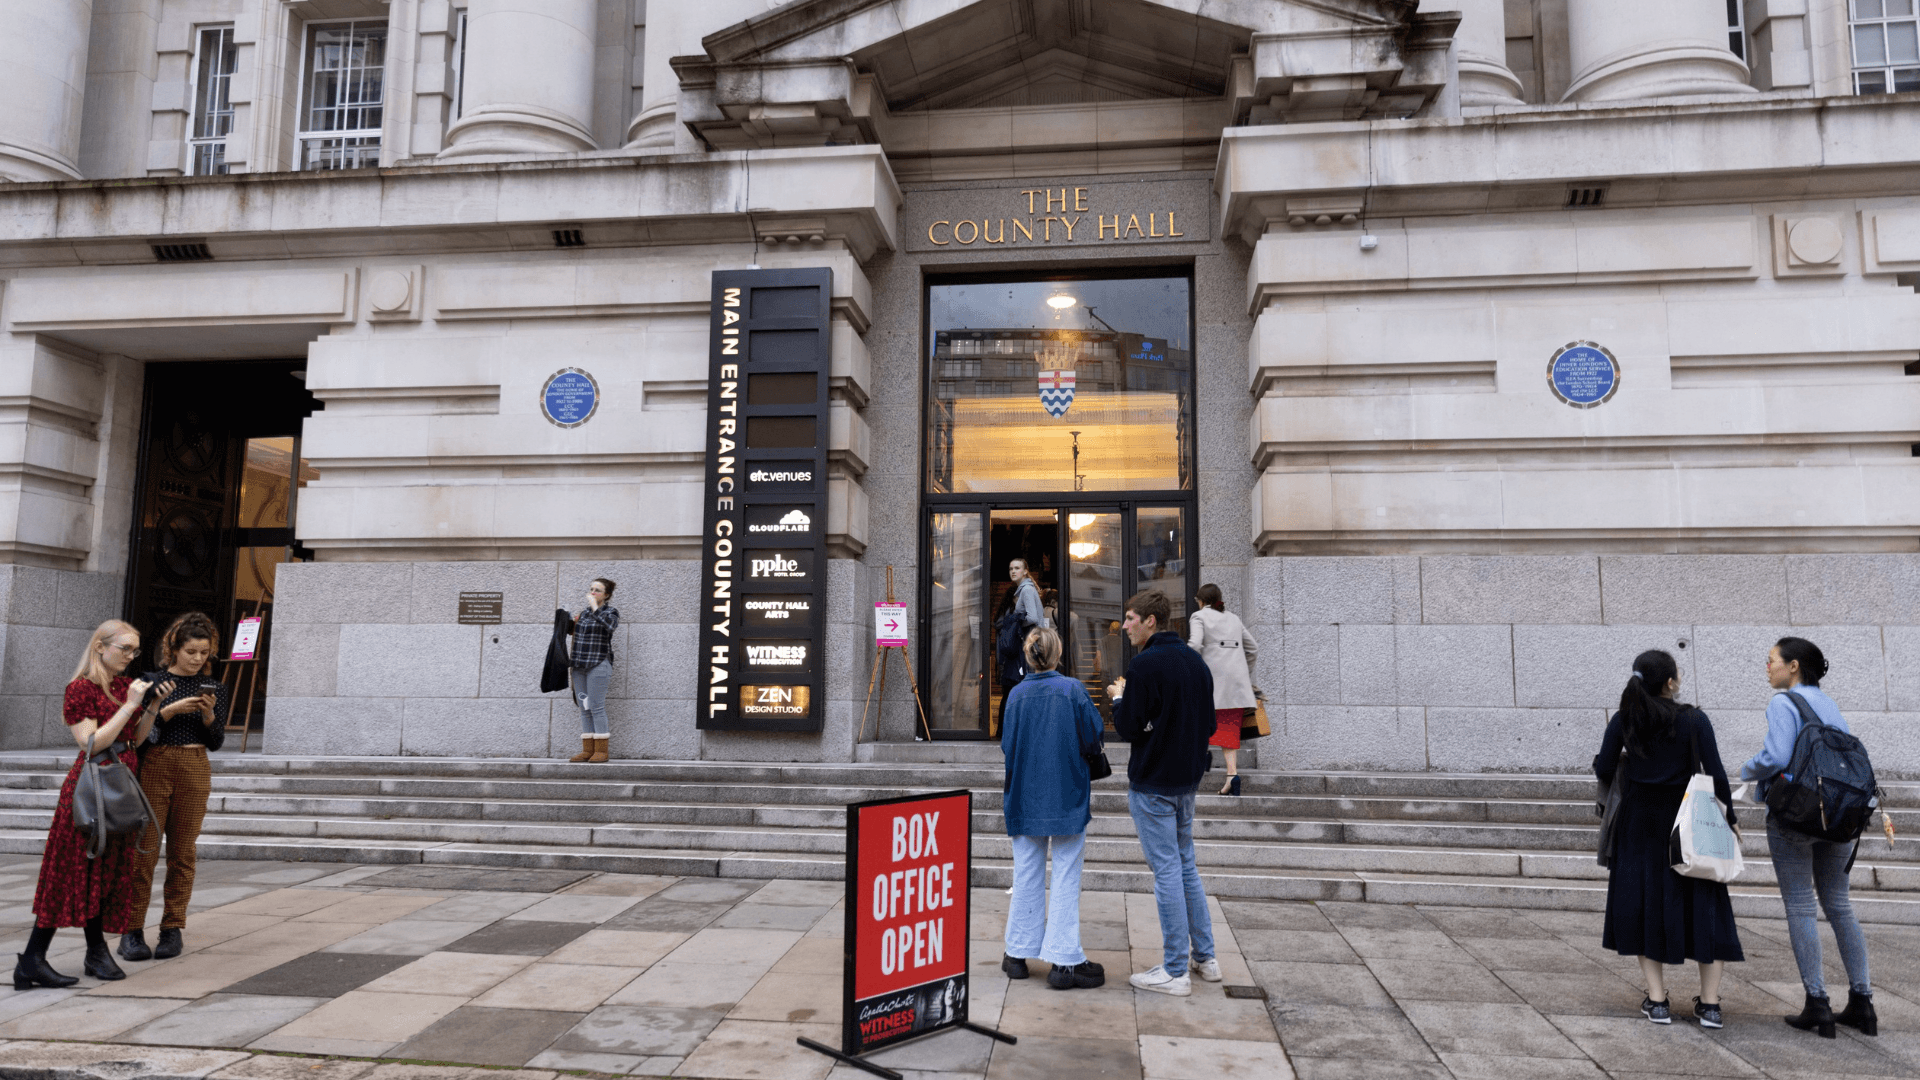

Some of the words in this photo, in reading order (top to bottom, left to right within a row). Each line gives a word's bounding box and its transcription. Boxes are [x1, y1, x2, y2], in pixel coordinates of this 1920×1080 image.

[1021, 187, 1089, 214] THE
[928, 216, 1080, 245] COUNTY
[1098, 211, 1184, 240] HALL
[722, 287, 740, 355] MAIN
[717, 364, 738, 511] ENTRANCE
[750, 470, 811, 482] etc.venues
[712, 519, 733, 637] COUNTY
[751, 554, 798, 577] pphe
[745, 601, 784, 610] COUNTY
[785, 601, 810, 610] HALL
[764, 610, 789, 619] ARTS
[746, 645, 806, 659] WITNESS
[709, 645, 729, 719] HALL
[758, 687, 792, 703] ZEN
[745, 705, 772, 713] DESIGN
[774, 705, 803, 713] STUDIO
[892, 811, 940, 862] BOX
[873, 862, 954, 921] OFFICE
[881, 917, 943, 975] OPEN
[859, 1008, 915, 1036] WITNESS
